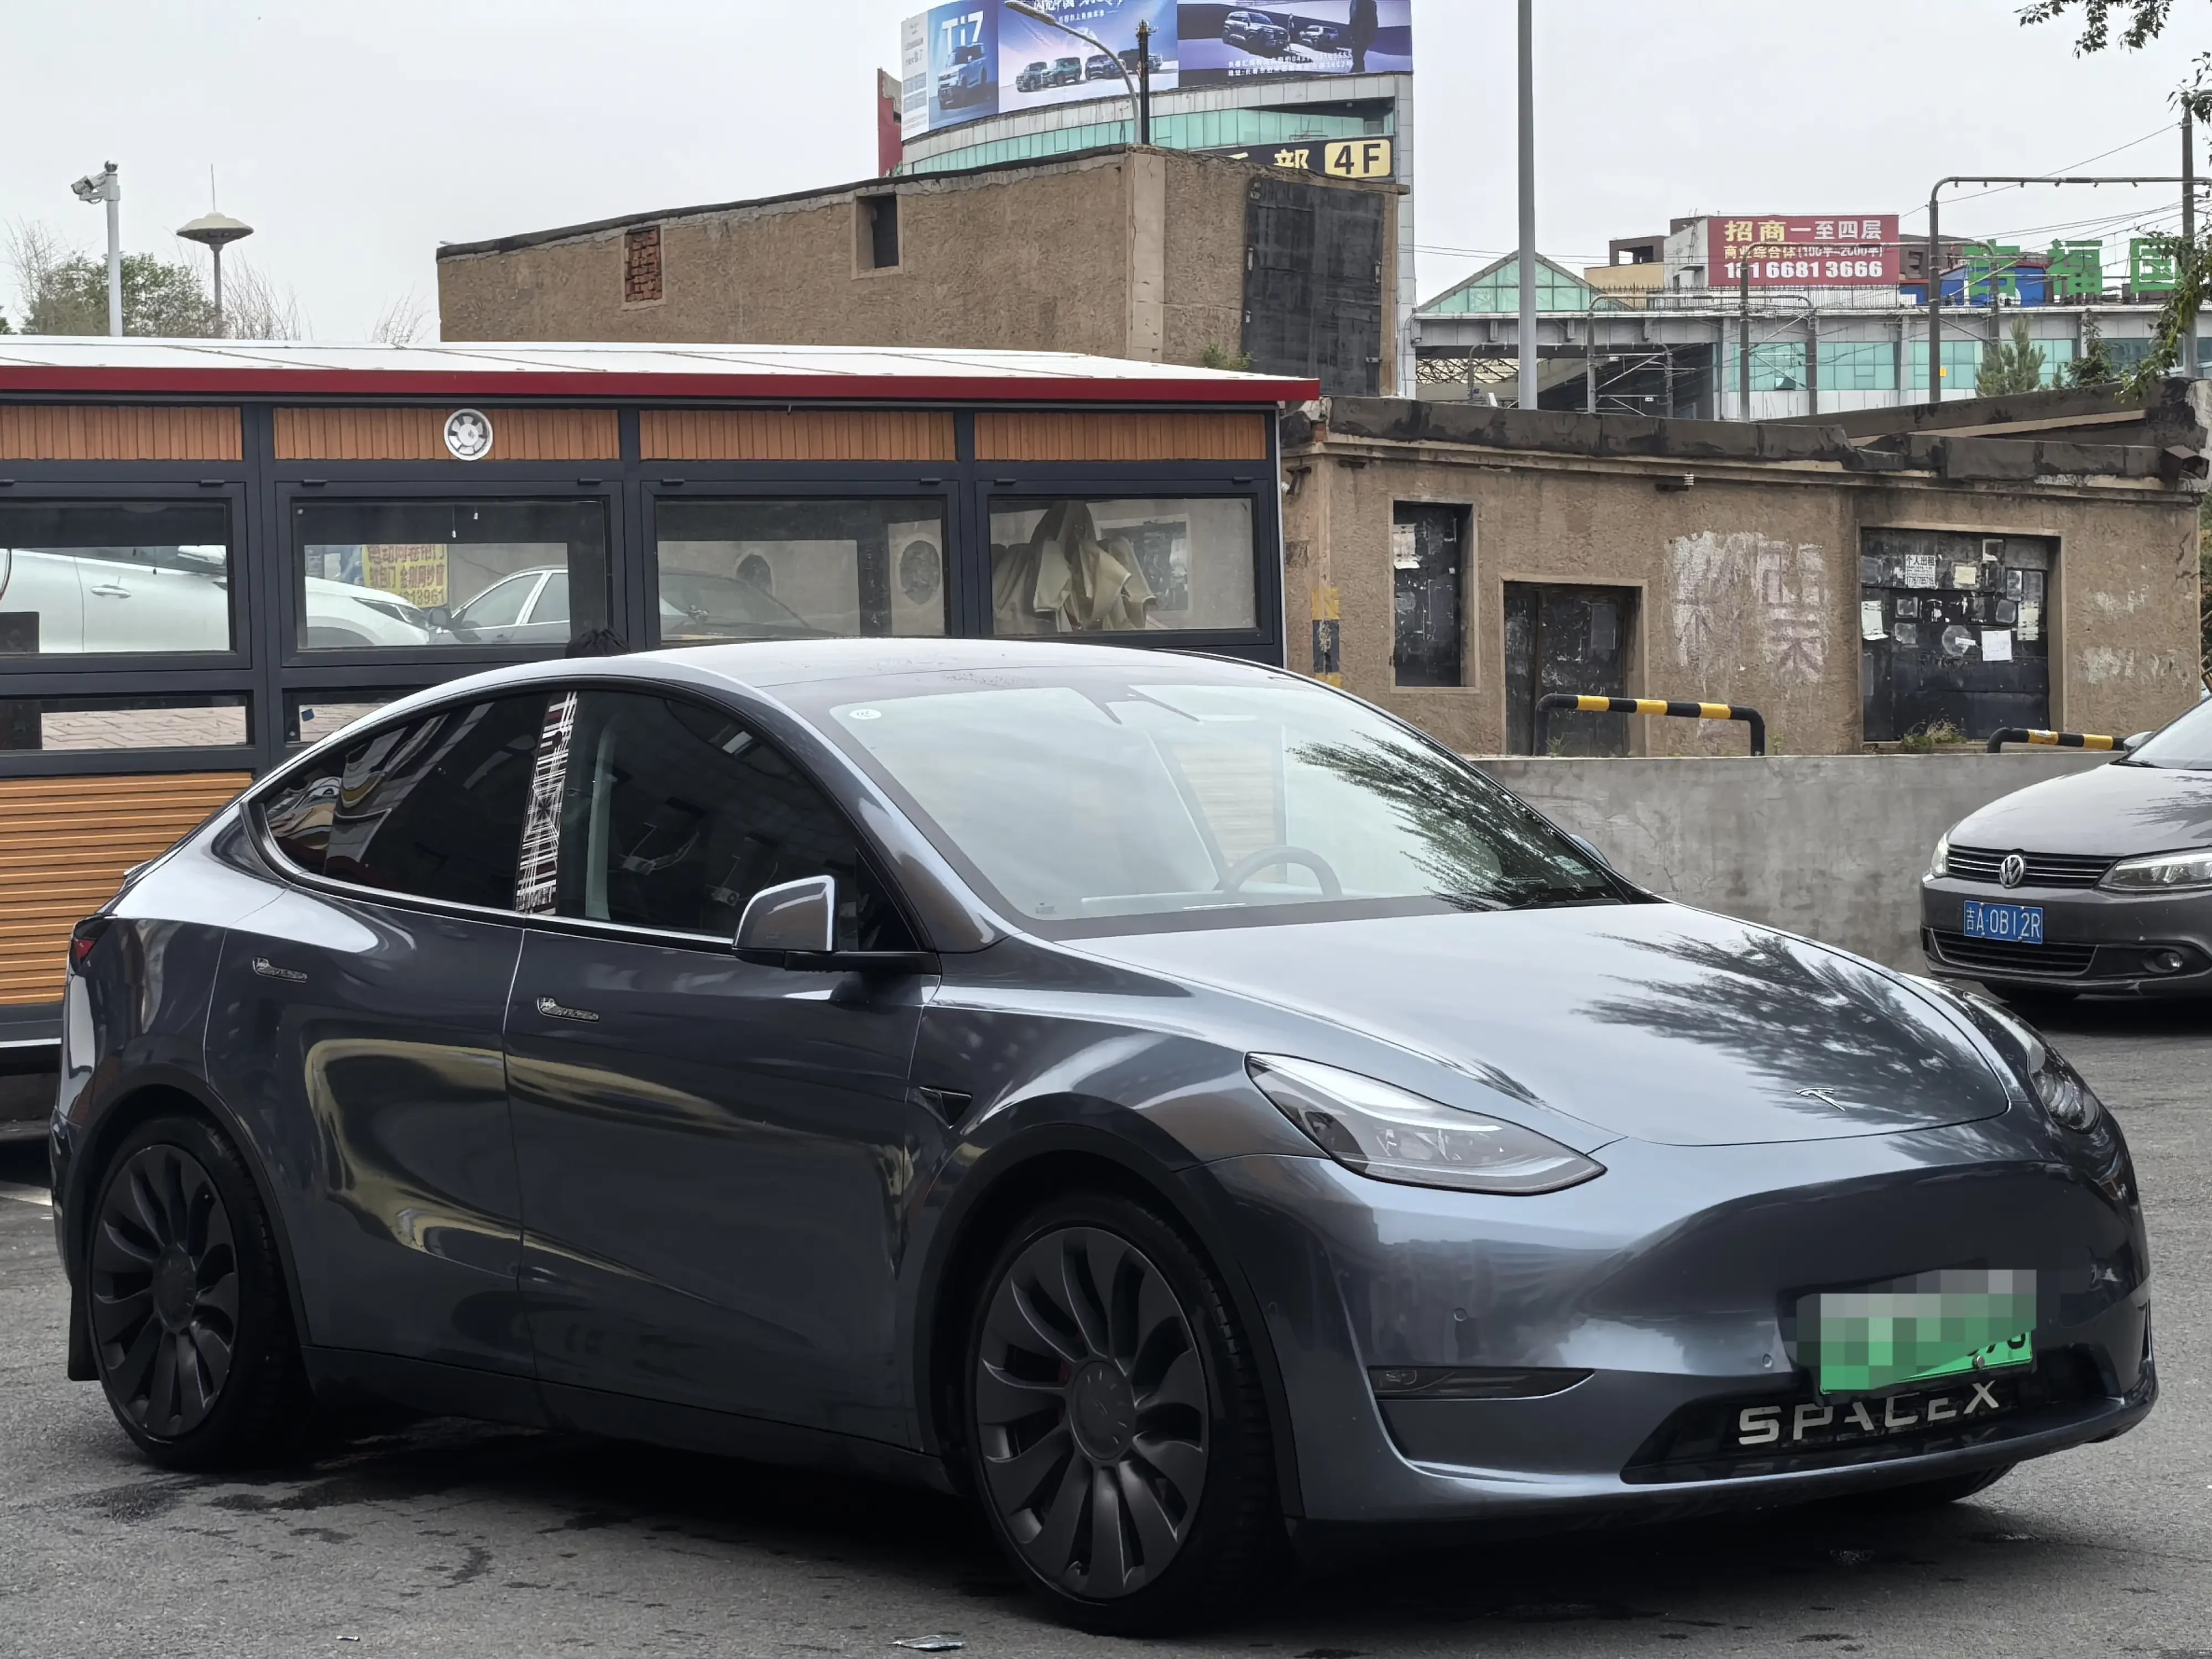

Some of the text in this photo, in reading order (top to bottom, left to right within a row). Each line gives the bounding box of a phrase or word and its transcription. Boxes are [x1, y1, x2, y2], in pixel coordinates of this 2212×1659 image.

[1334, 143, 1381, 175] 4F
[1766, 261, 1820, 278] 6681
[1825, 261, 1882, 278] 3666
